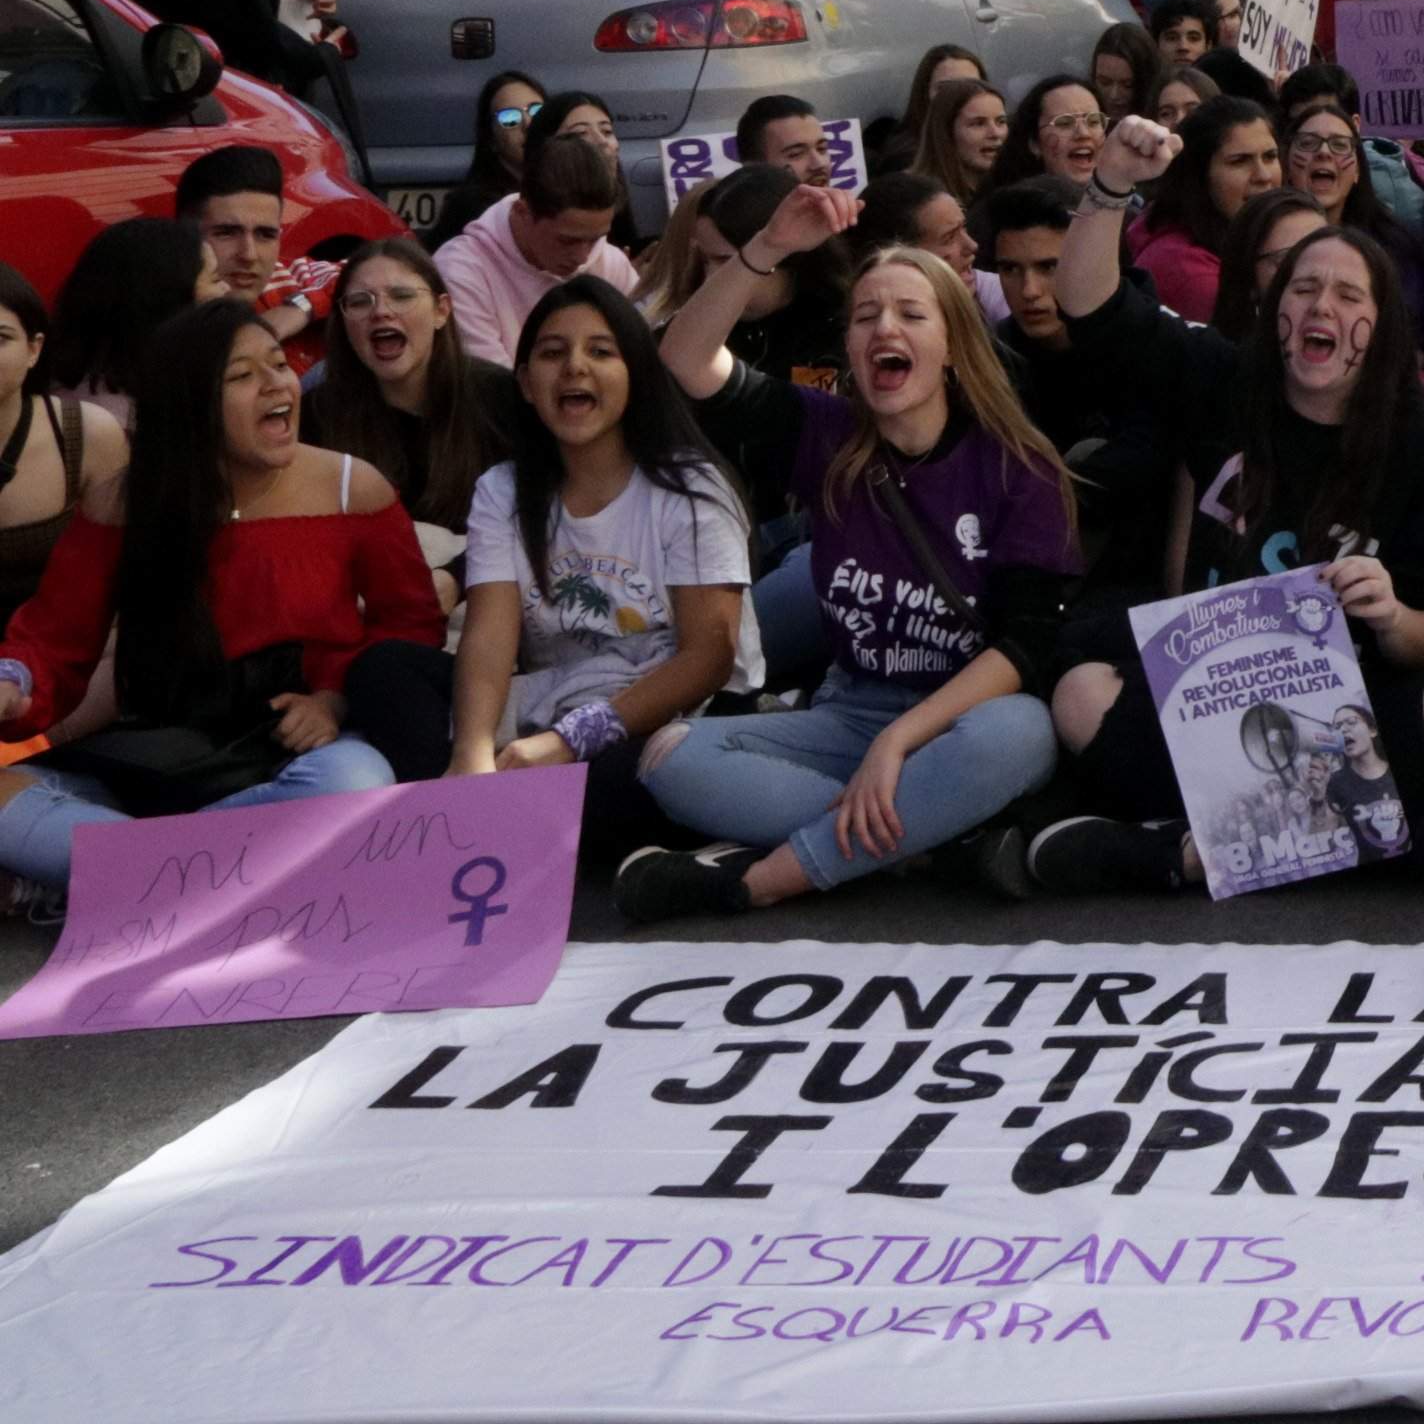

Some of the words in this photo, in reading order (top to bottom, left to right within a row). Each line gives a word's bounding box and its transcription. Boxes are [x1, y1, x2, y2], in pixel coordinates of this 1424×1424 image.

[1242, 1, 1272, 54] SOY
[828, 557, 884, 605] Ens
[1185, 593, 1248, 632] Lliures
[1253, 588, 1261, 604] i
[852, 639, 878, 671] Ens
[1164, 613, 1283, 665] Combatives
[1207, 646, 1298, 681] FEMINISME
[1178, 707, 1187, 723] I
[1192, 673, 1344, 721] ANTICAPITALISTA
[1182, 657, 1332, 704] REVOLUCIONARI
[345, 813, 475, 868] un
[1227, 841, 1253, 875] 8
[1260, 825, 1355, 866] Març
[210, 894, 373, 972] pas
[605, 972, 1230, 1030] CONTRA
[367, 1043, 601, 1110] LA
[648, 1112, 817, 1199] I
[150, 1235, 676, 1290] SINDICAT
[661, 1232, 1298, 1290] D'ESTUDIANTS
[658, 1295, 1111, 1344] ESQUERRA
